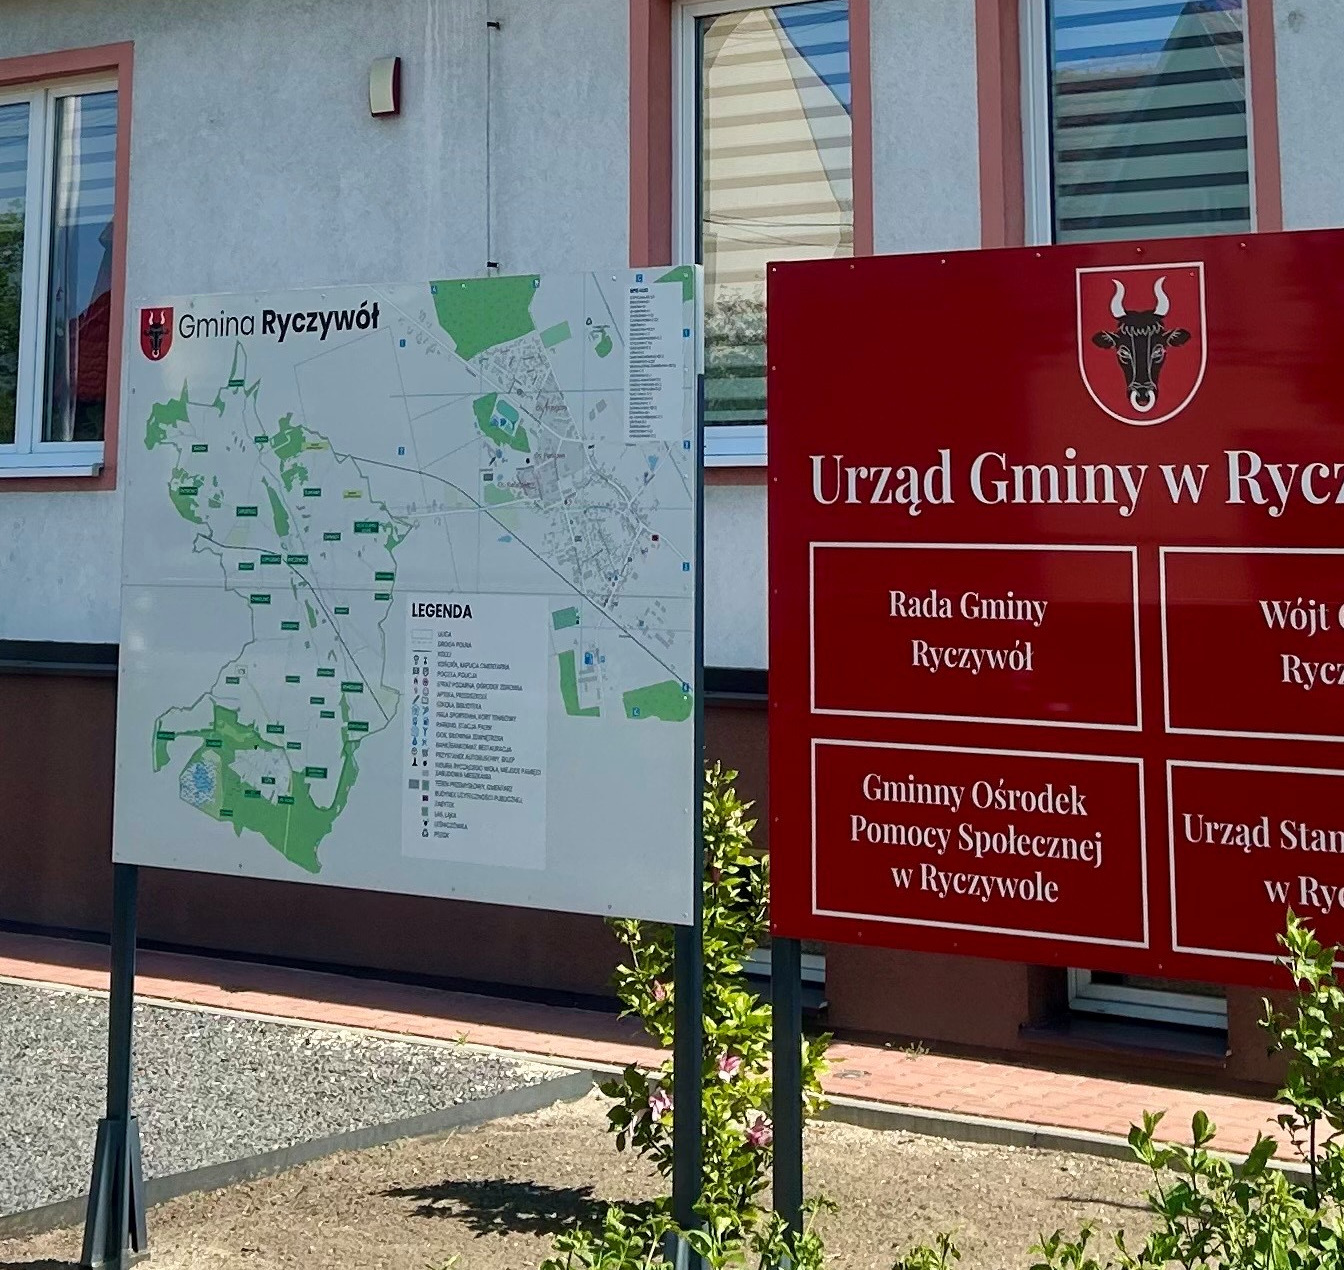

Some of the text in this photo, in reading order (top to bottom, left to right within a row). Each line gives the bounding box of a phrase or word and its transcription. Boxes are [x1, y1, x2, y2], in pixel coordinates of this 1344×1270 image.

[179, 300, 379, 342] Gmina Ryczywół
[809, 449, 954, 516] Urząd
[971, 448, 1148, 516] Gminy
[1159, 465, 1209, 503] w
[412, 603, 472, 618] LEGENDA
[889, 589, 1048, 627] Rada Gminy
[1259, 597, 1330, 636] Wójt
[912, 640, 1033, 674] Ryczywół
[863, 774, 1087, 815] Gminny Ośrodek
[850, 815, 1101, 868] Pomocy Społecznej
[1183, 814, 1270, 853] Urząd
[891, 863, 1058, 902] w Ryczywole
[1264, 881, 1289, 903] w
